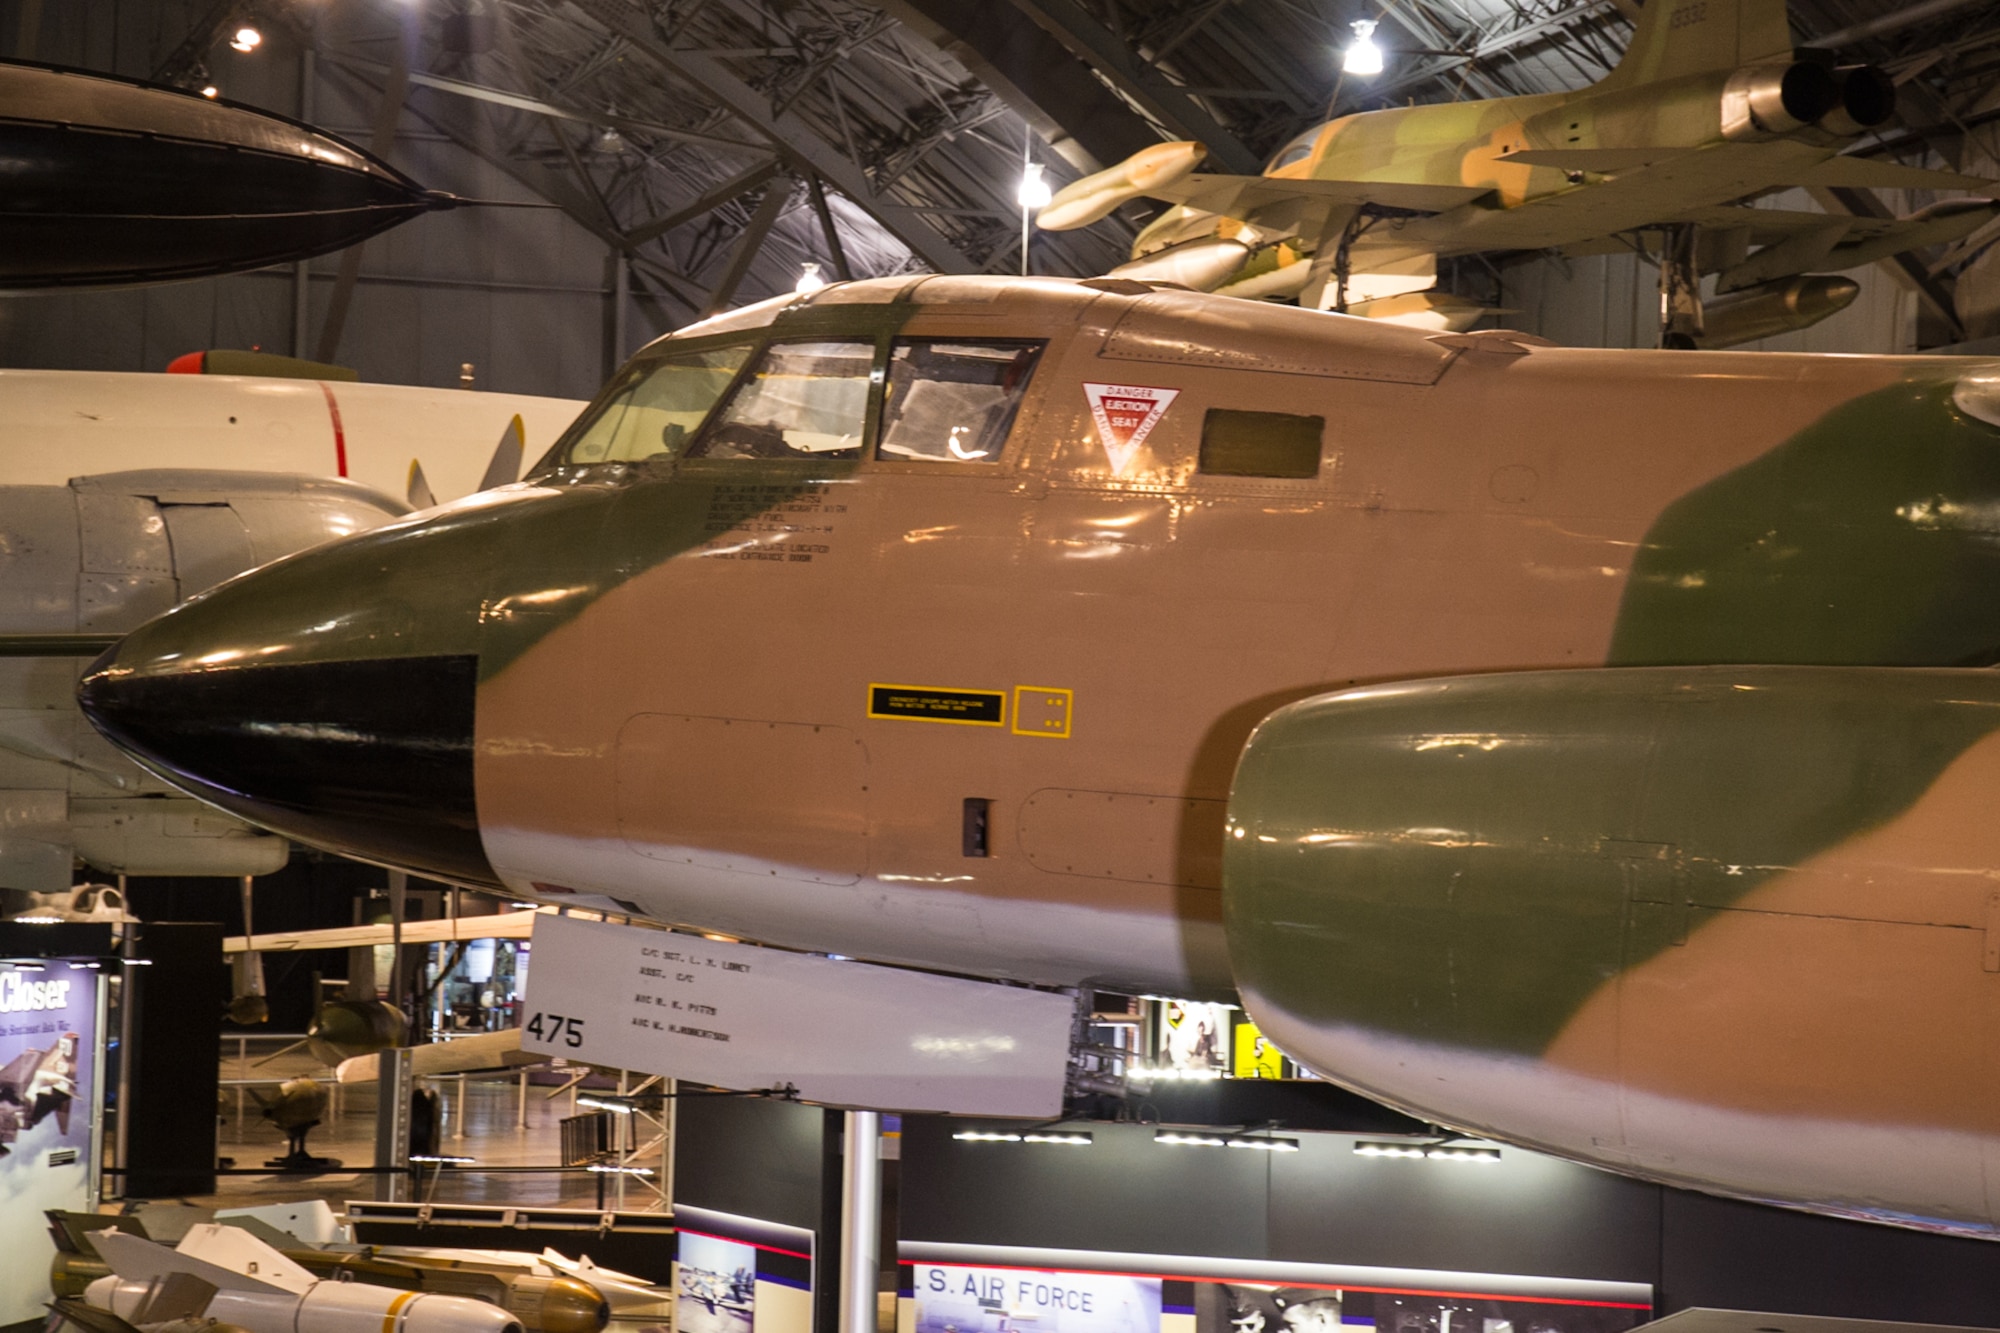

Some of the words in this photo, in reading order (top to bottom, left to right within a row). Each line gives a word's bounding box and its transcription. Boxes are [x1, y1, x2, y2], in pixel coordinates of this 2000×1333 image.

[1106, 386, 1154, 398] DANGER
[1105, 399, 1151, 412] EJECTION
[1111, 416, 1139, 428] SEAT
[0, 971, 70, 1013] Closer
[526, 1012, 585, 1048] 475
[963, 1273, 1006, 1300] AIR
[1018, 1280, 1094, 1313] FORCE
